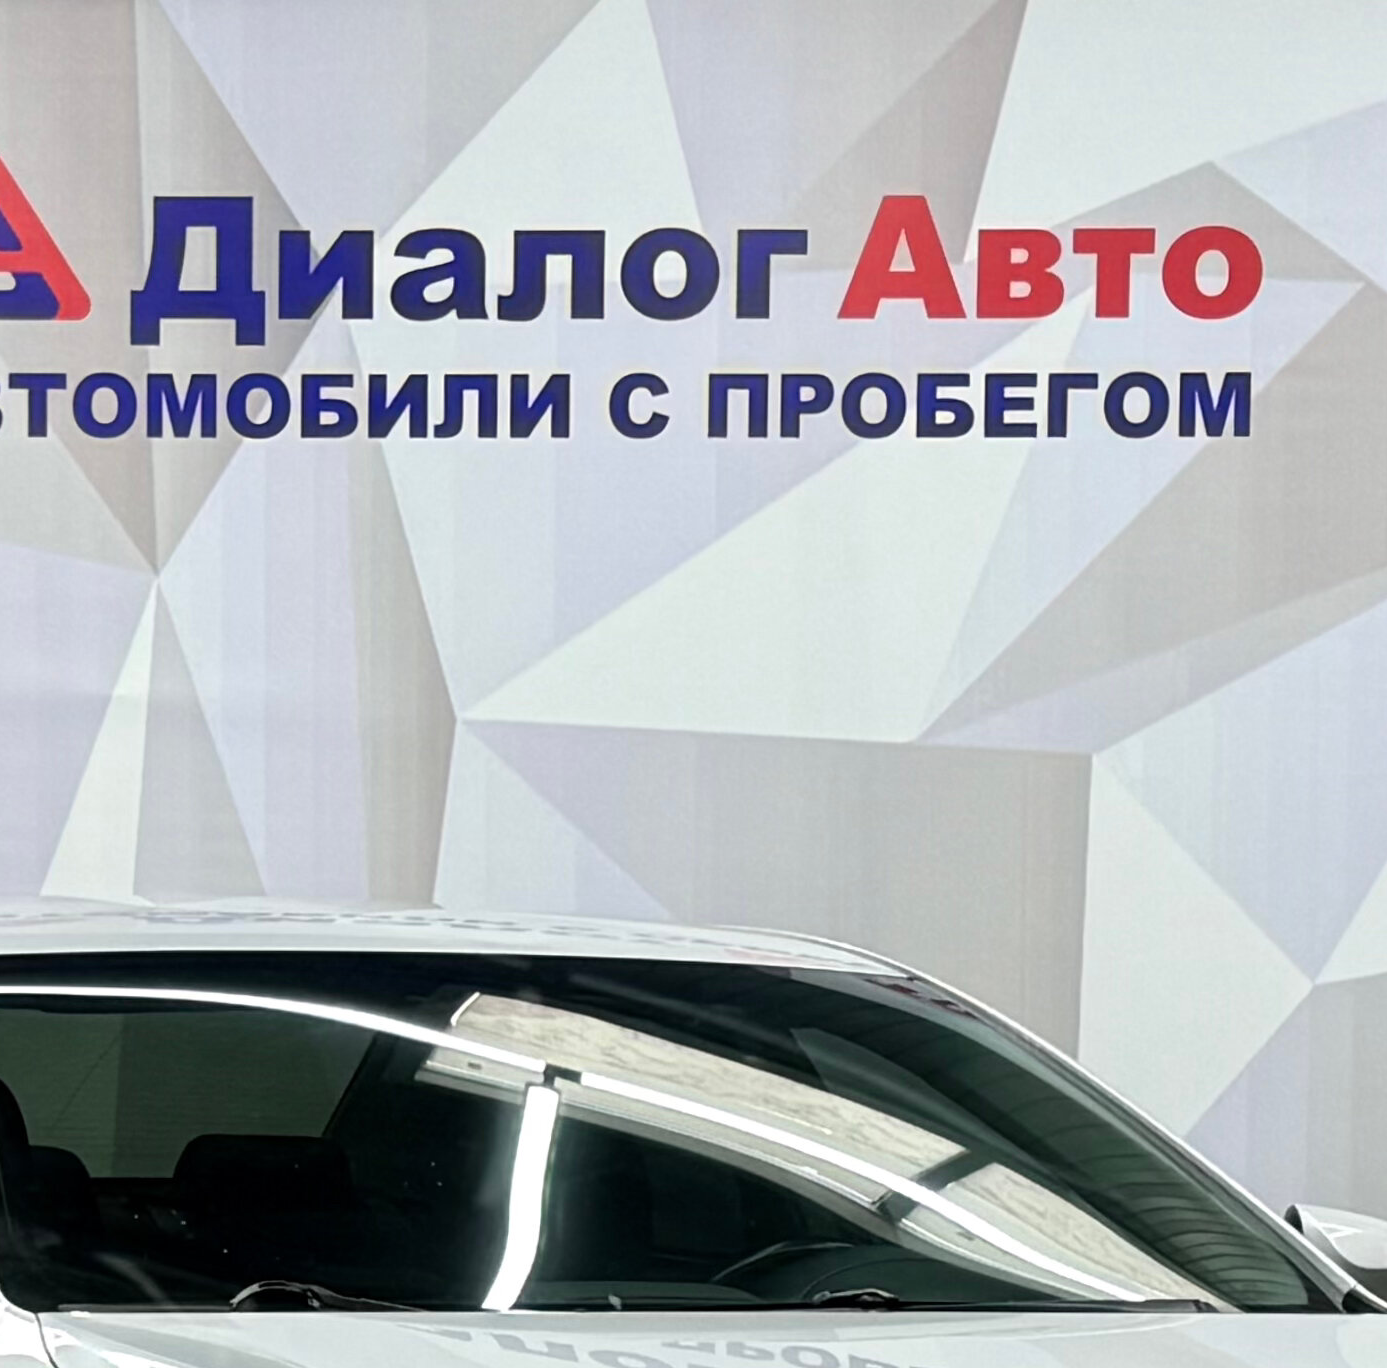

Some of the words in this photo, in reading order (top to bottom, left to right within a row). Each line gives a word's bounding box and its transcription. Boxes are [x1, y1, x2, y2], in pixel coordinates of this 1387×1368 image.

[130, 196, 808, 346] Диалог
[837, 195, 1264, 320] Авто
[608, 371, 669, 440] С
[706, 371, 1252, 440] ПРОБЕГОМ
